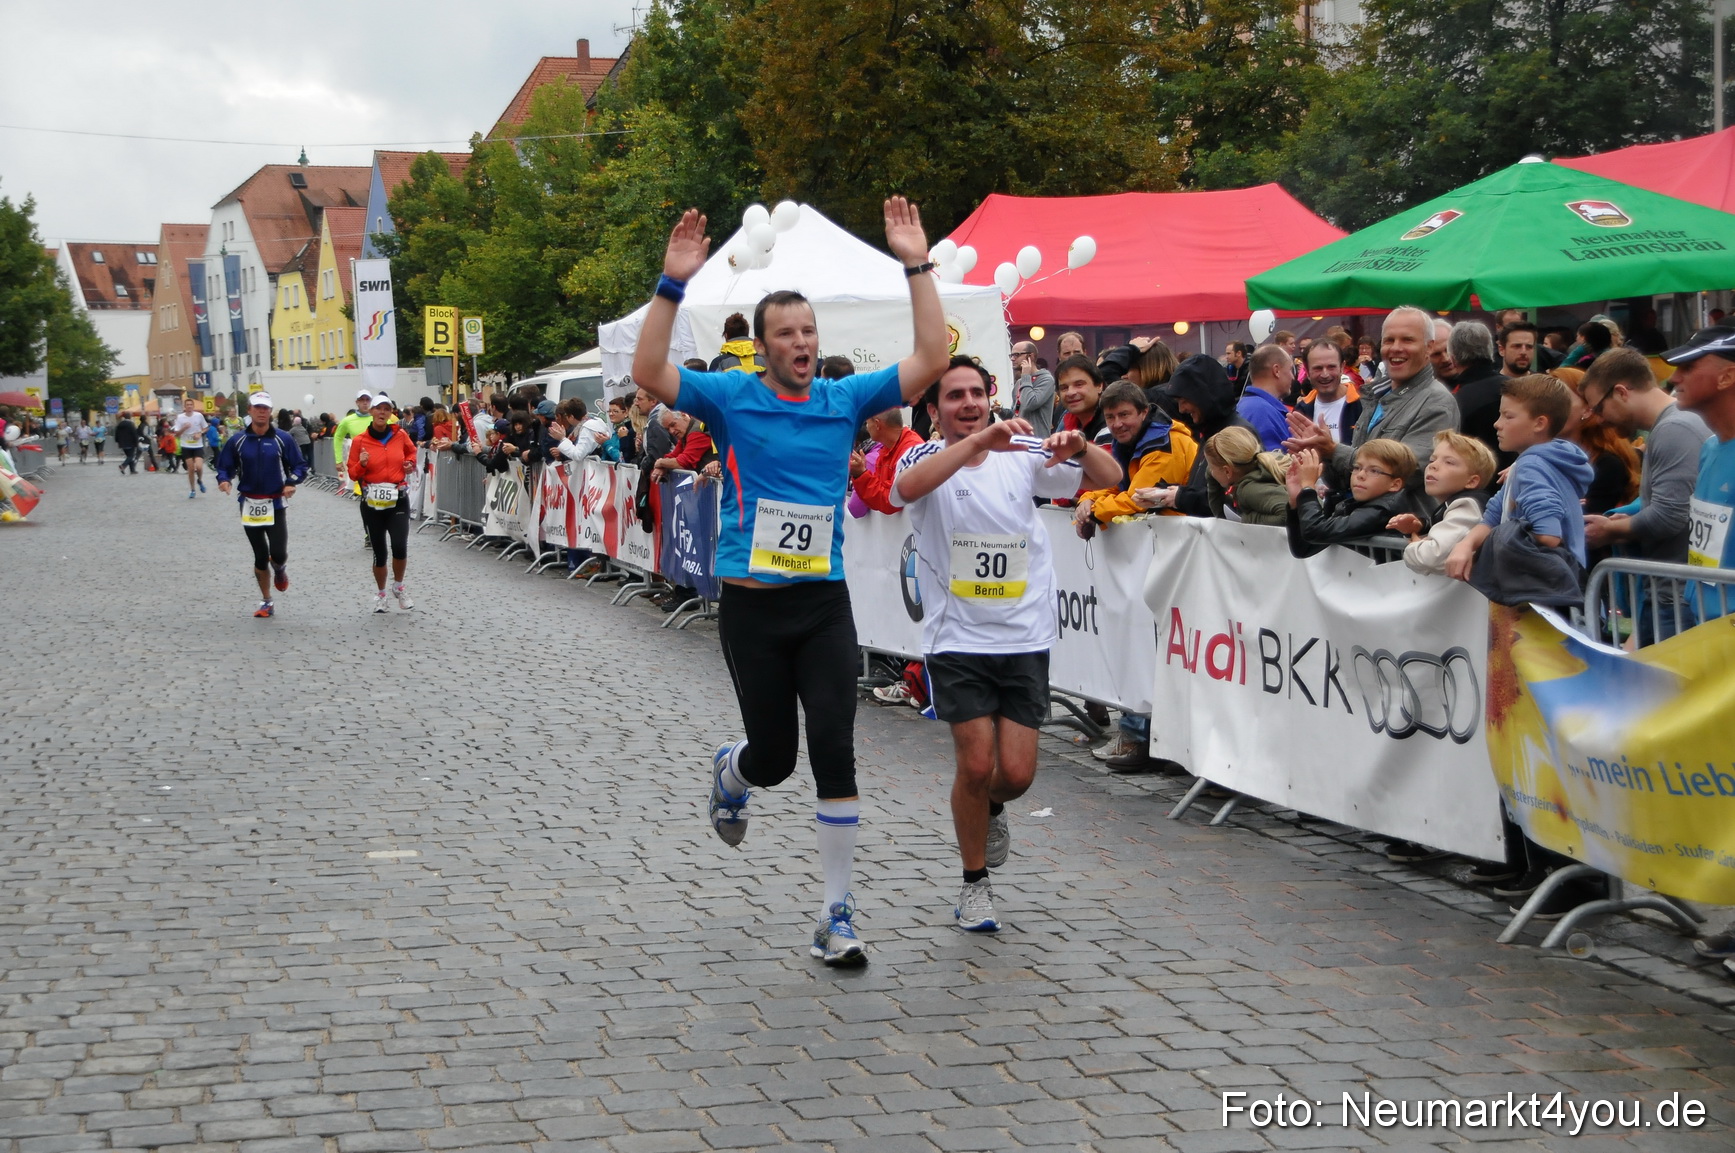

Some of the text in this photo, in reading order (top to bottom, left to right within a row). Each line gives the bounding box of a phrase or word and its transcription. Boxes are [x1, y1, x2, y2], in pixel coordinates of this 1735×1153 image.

[1570, 230, 1687, 247] Neumarkter
[1560, 239, 1727, 262] Lammsbräu
[1322, 257, 1424, 274] Lammsbräu
[359, 280, 391, 292] swn
[429, 308, 455, 319] Block
[434, 321, 450, 345] B
[852, 347, 881, 364] Sie.
[373, 489, 392, 501] 185
[249, 505, 268, 517] 269
[758, 506, 824, 521] PARTL Neumarkt
[778, 522, 813, 551] 29
[952, 540, 1018, 550] PARTL Neumarkt
[771, 555, 812, 570] Michael
[975, 552, 1008, 579] 30
[974, 585, 1005, 597] Bernd
[1056, 585, 1099, 639] port
[1166, 606, 1353, 715] Audi BKK
[1615, 830, 1665, 856] Palisaden
[1674, 842, 1714, 861] Stufen
